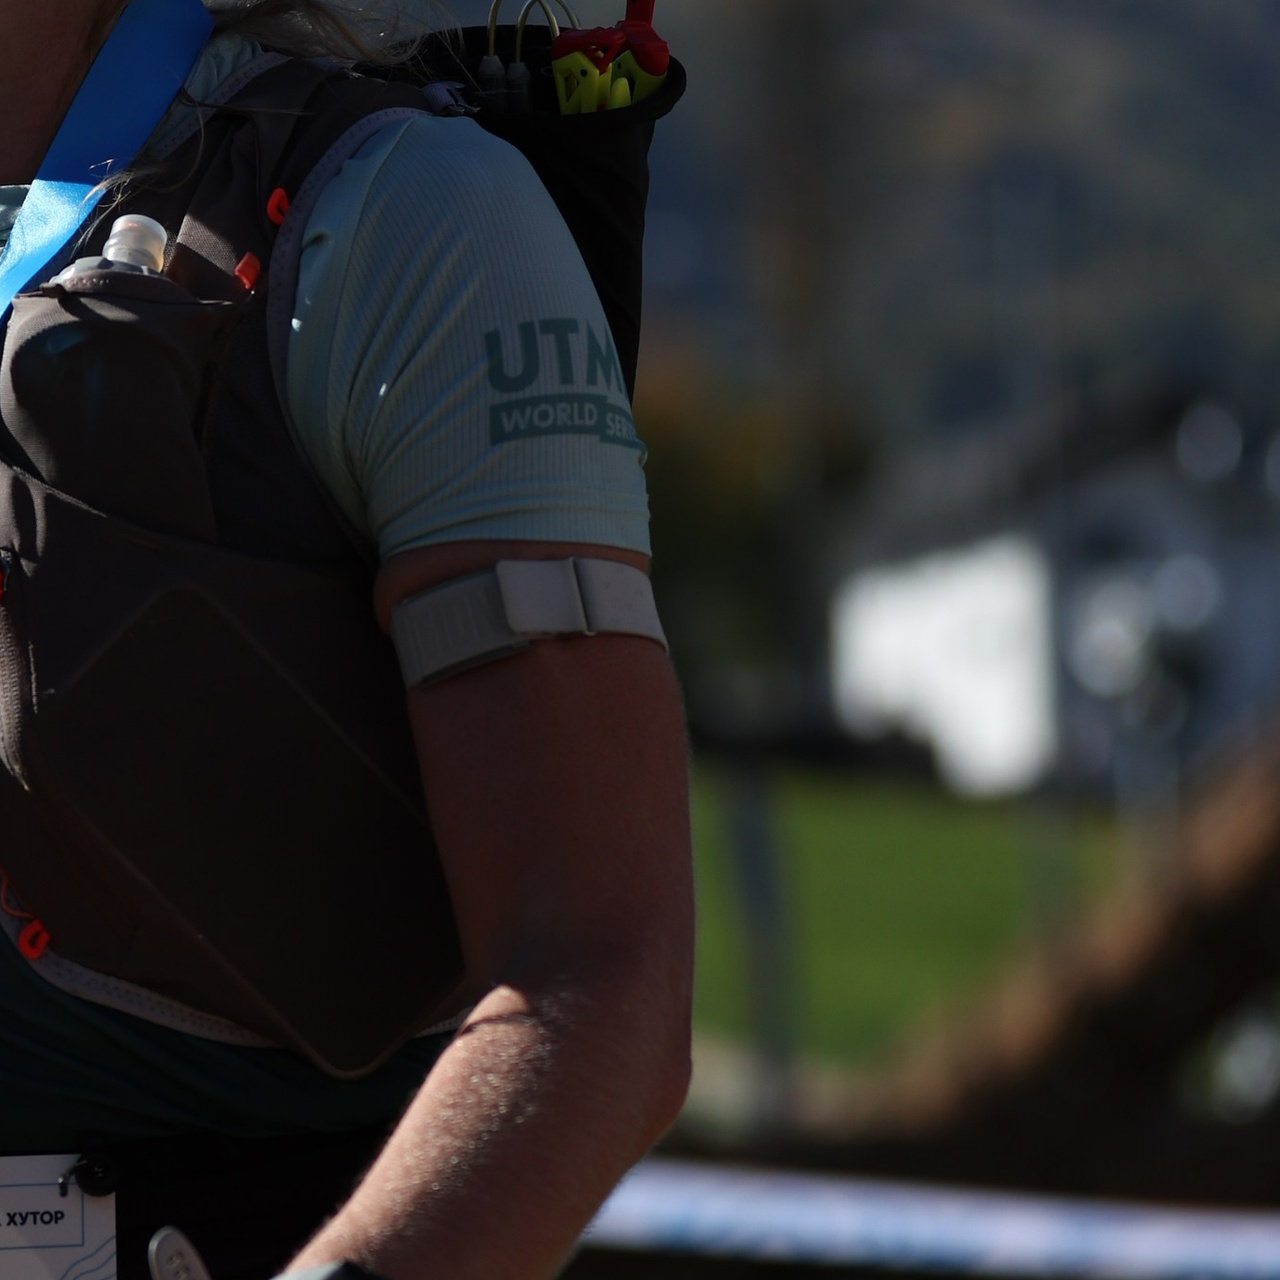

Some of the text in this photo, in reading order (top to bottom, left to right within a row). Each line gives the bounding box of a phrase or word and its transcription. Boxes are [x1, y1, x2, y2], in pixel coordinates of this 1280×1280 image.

[484, 317, 628, 395] UTM
[500, 402, 598, 434] WORLD
[6, 1210, 65, 1227] ХУТОР
